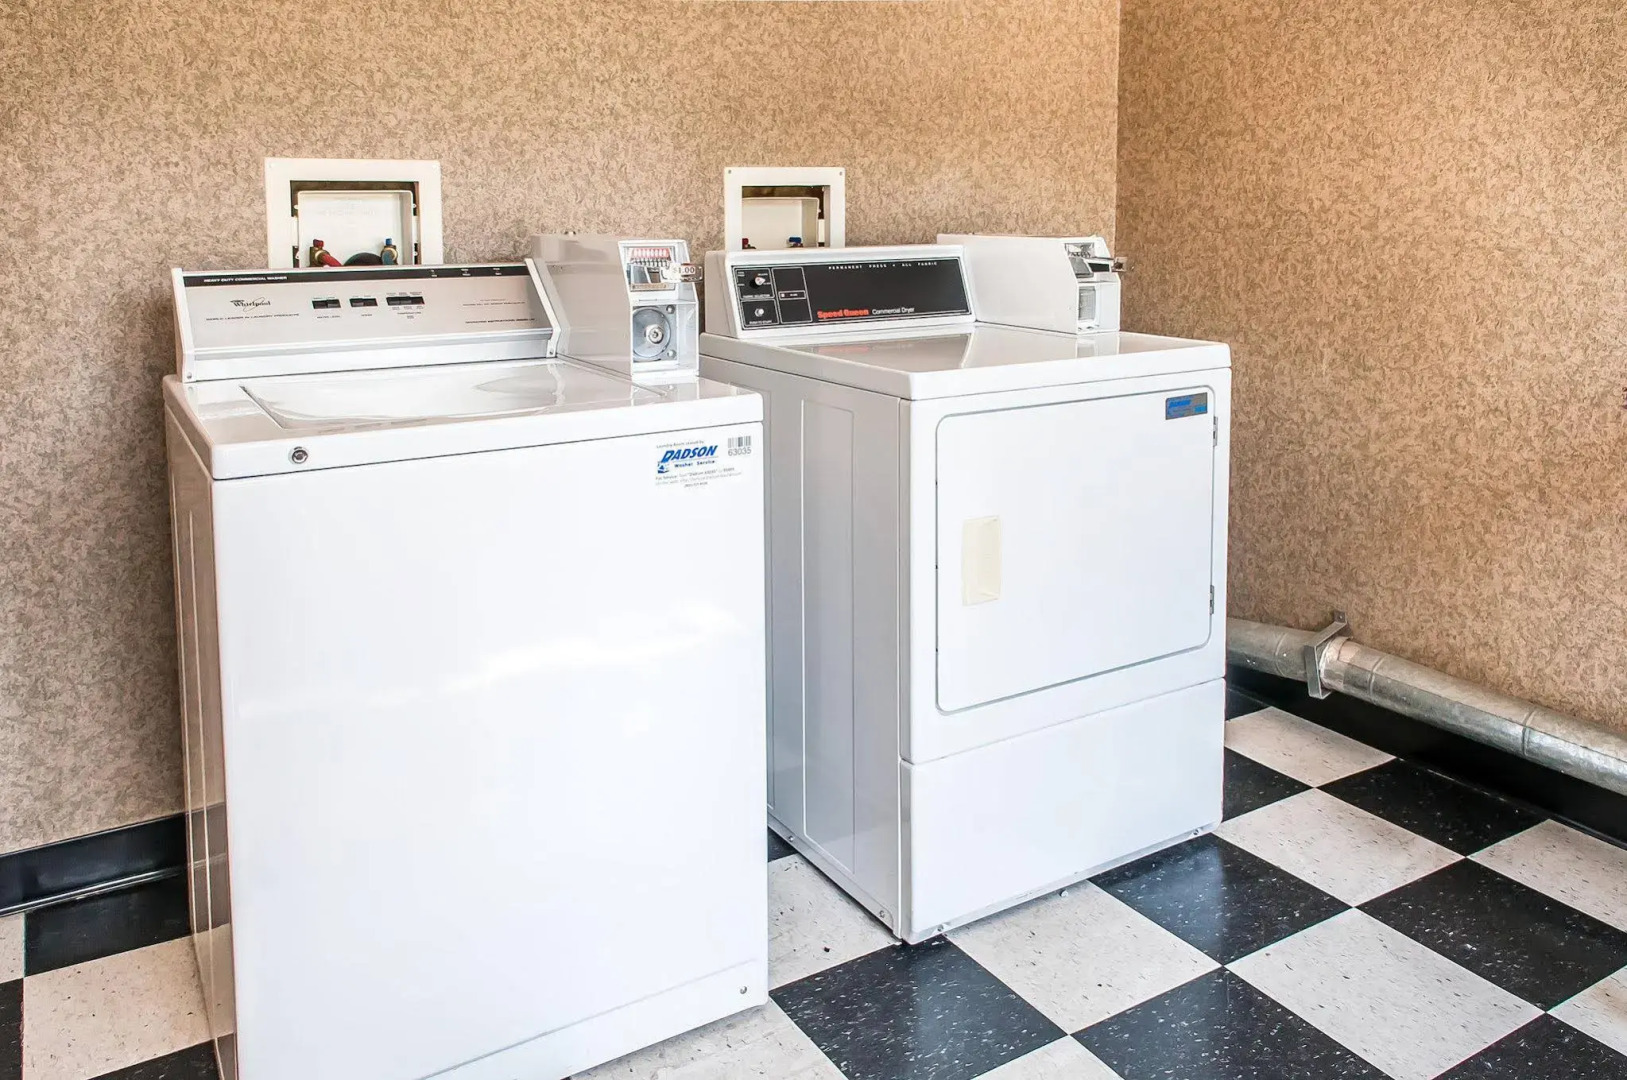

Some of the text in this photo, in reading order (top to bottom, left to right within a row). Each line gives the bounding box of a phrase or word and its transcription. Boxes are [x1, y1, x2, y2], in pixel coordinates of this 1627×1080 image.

[229, 299, 271, 308] Whirlpool
[817, 308, 869, 319] Speed Queen
[872, 307, 900, 315] Commercial
[660, 445, 718, 463] DADSON
[727, 447, 752, 456] 63035
